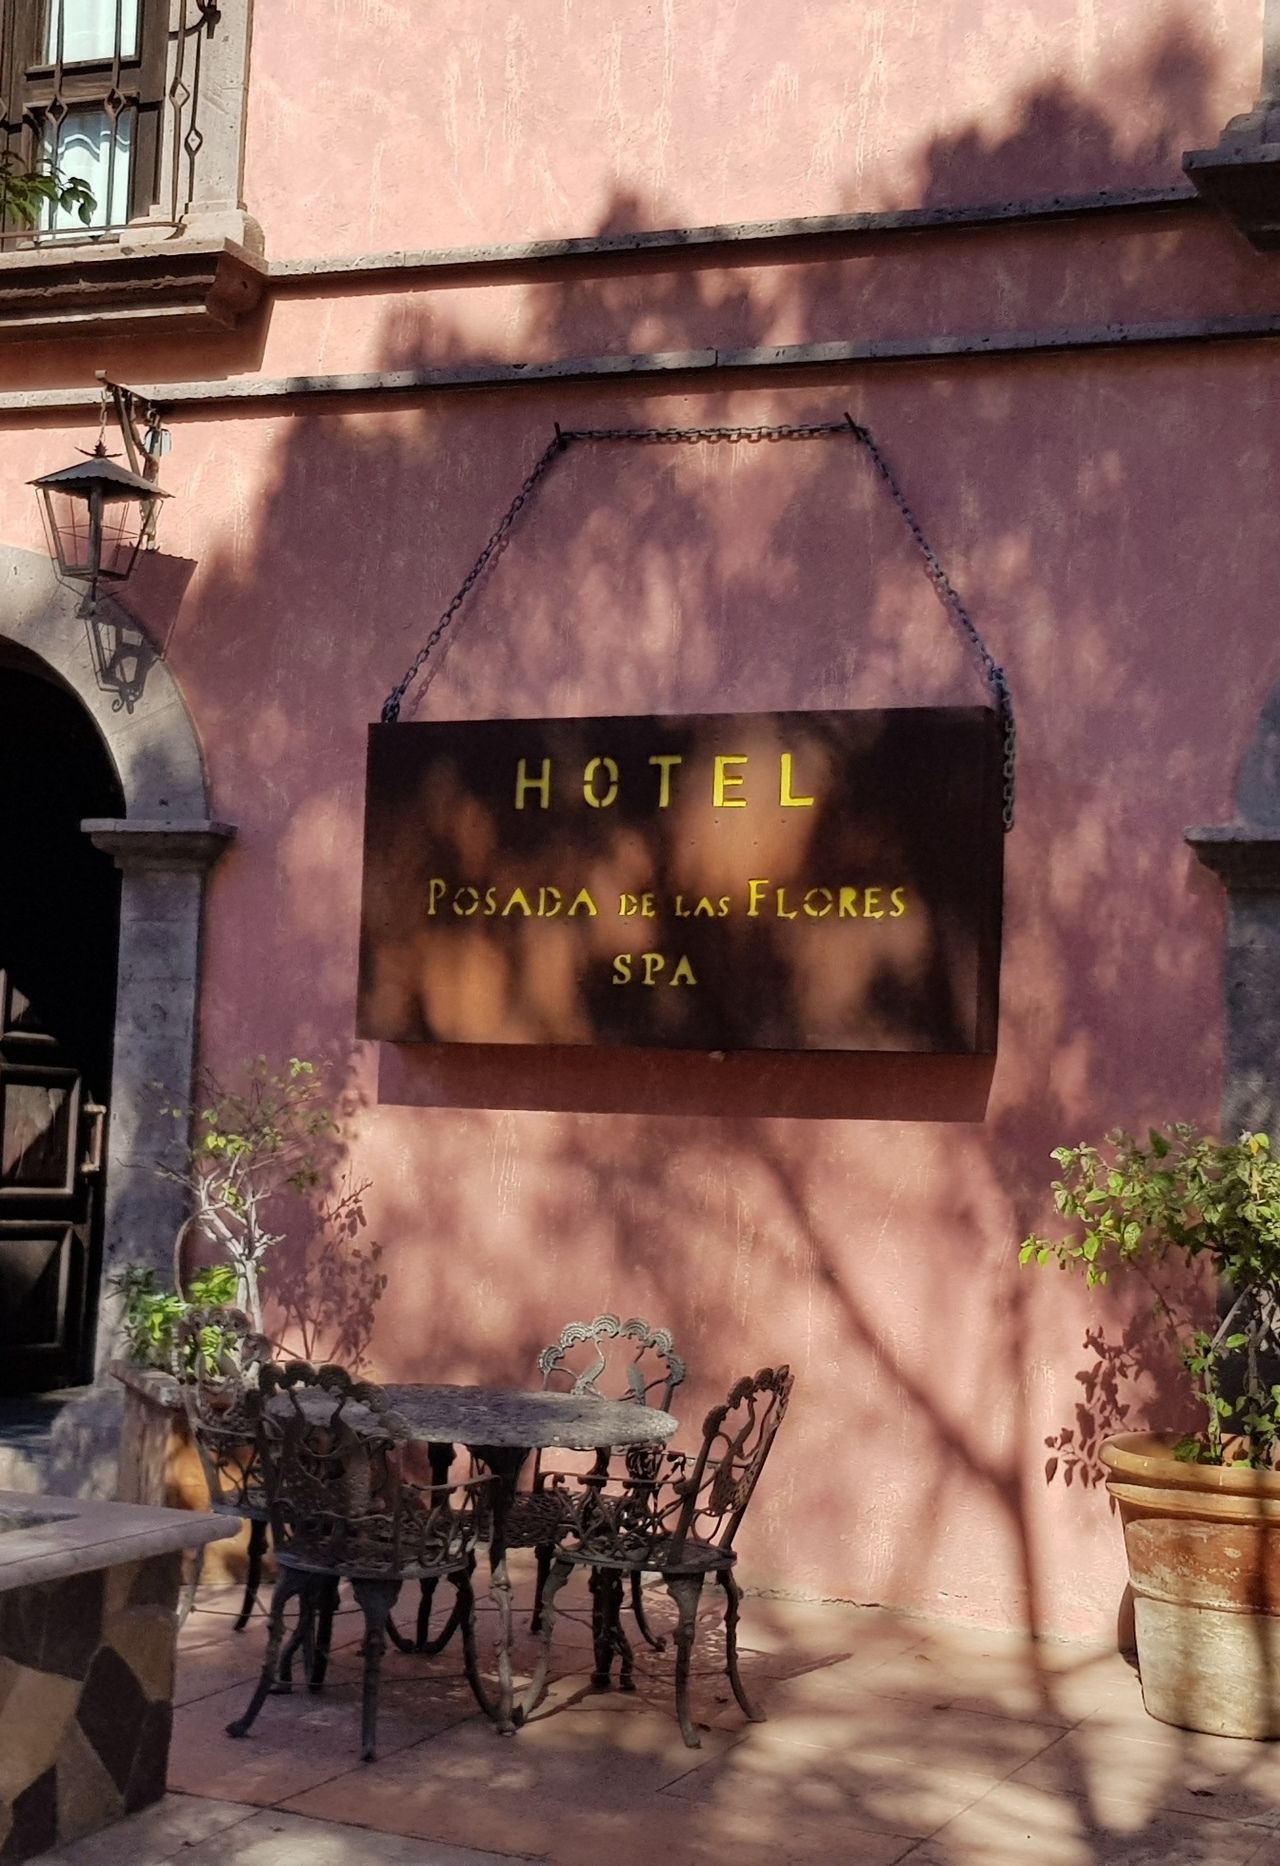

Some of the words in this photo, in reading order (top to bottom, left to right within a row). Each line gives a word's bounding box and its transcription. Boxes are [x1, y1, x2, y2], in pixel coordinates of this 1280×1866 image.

[515, 753, 815, 810] HOTEL
[427, 878, 598, 918] POSADA
[618, 893, 657, 918] DE
[675, 895, 731, 918] LAS
[747, 879, 906, 920] FLORES
[612, 953, 698, 987] SPA
